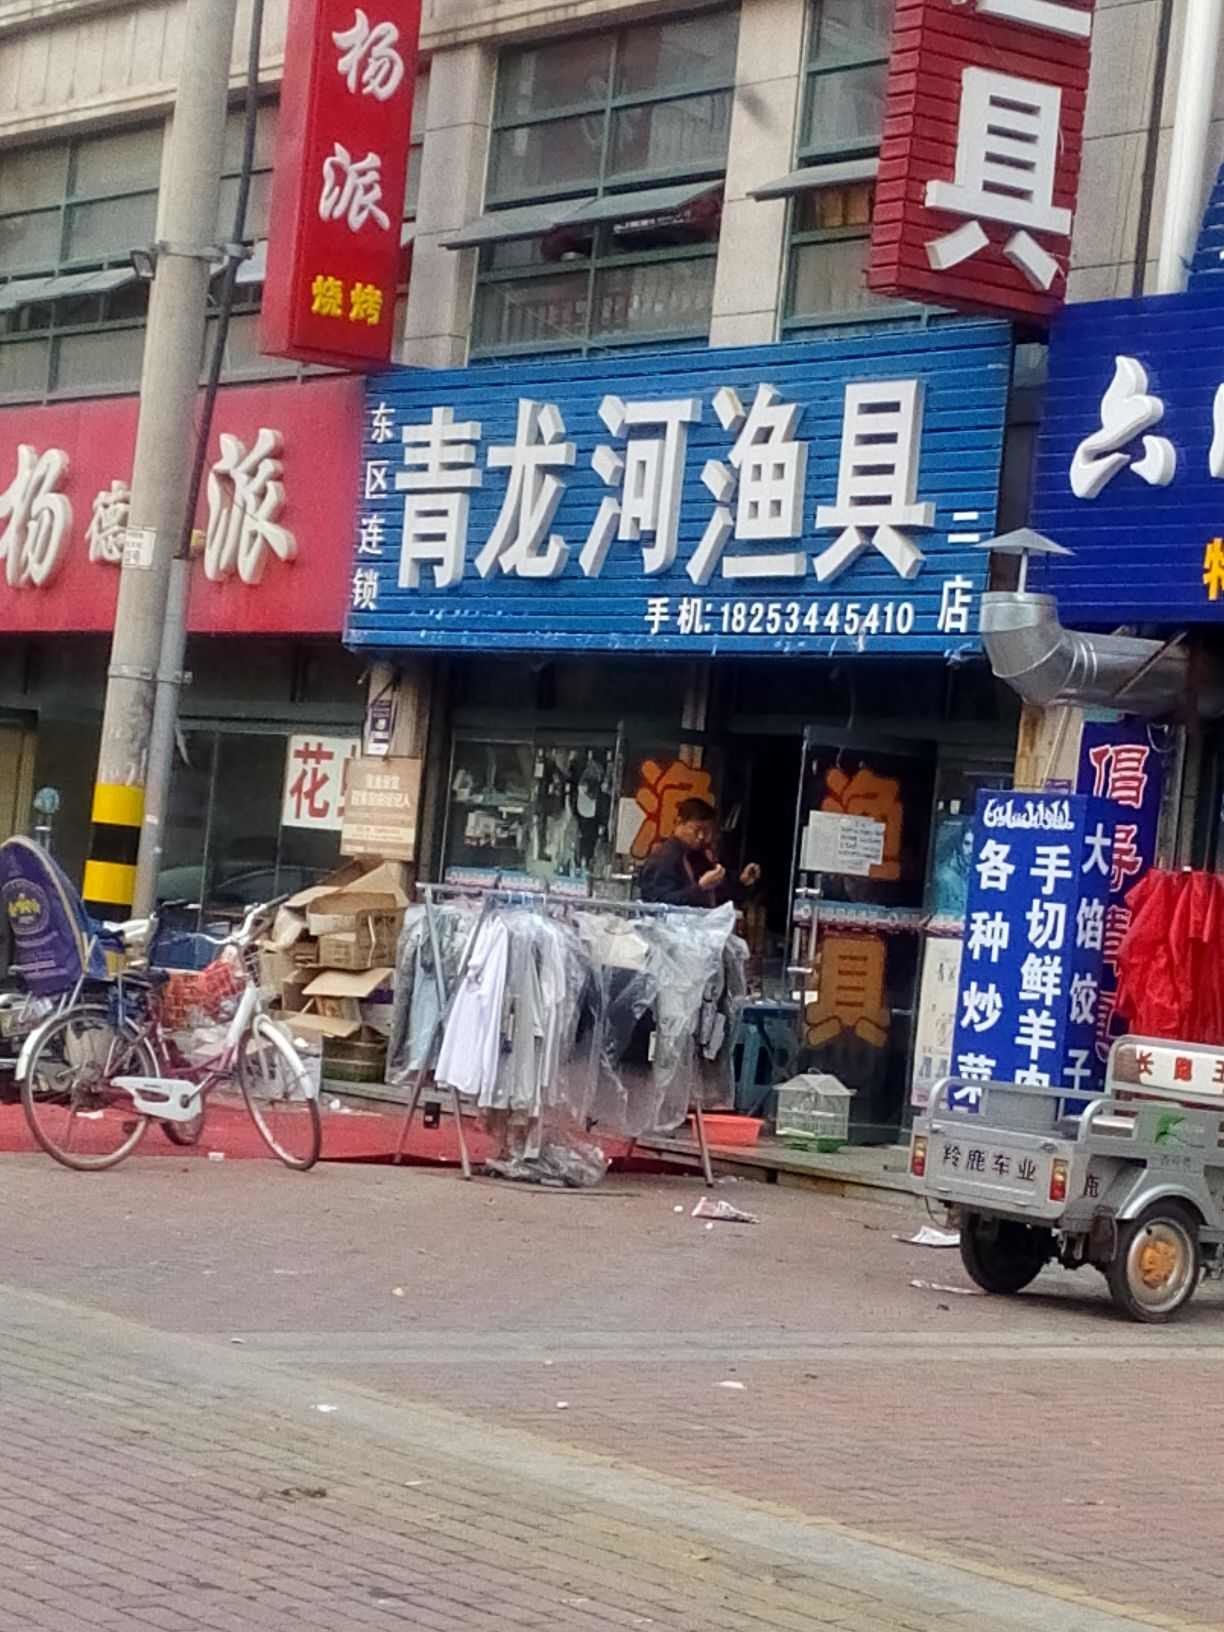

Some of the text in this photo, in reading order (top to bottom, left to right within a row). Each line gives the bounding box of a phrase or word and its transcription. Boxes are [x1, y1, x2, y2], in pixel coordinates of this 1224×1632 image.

[318, 8, 404, 232] 杨派
[924, 0, 1091, 291] 具
[311, 275, 383, 326] 烧烤
[351, 402, 396, 611] 东区连锁
[394, 378, 937, 589] 青龙河渔具
[953, 838, 1016, 1104] 各种炒菜
